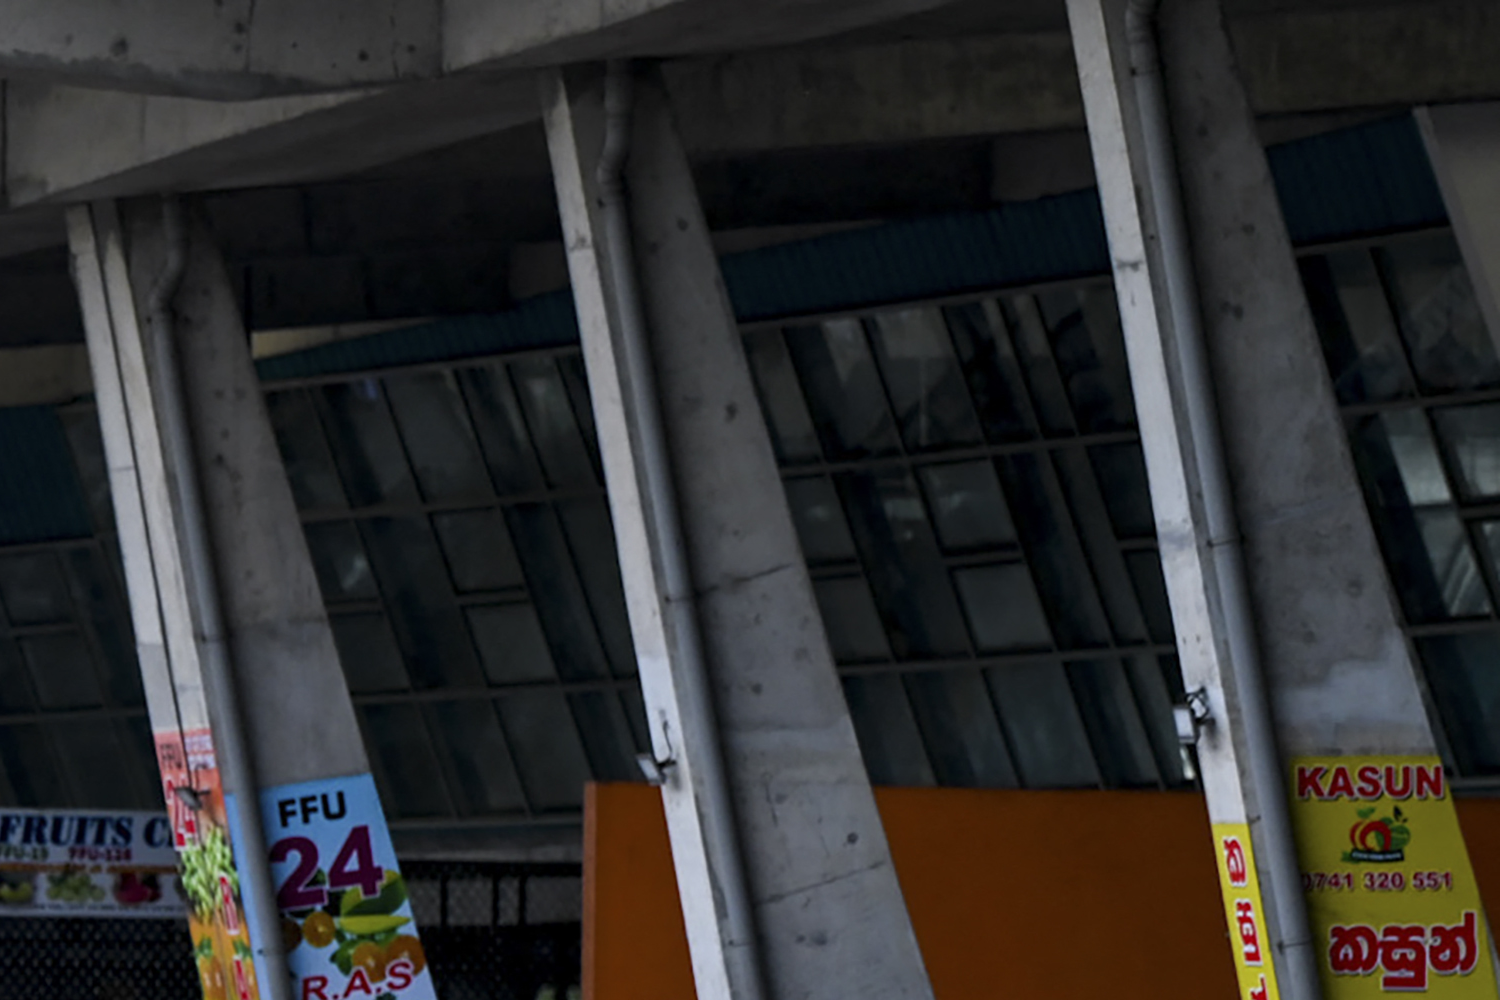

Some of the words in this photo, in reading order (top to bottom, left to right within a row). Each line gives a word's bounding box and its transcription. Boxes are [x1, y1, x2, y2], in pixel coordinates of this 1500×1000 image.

[1297, 764, 1445, 799] KASUN
[278, 791, 347, 828] FFU
[0, 815, 135, 847] FRUITS
[144, 816, 173, 849] C
[268, 824, 385, 912] 24
[1363, 871, 1405, 890] 320
[1412, 871, 1452, 890] 551
[1329, 910, 1478, 990] කසුන්
